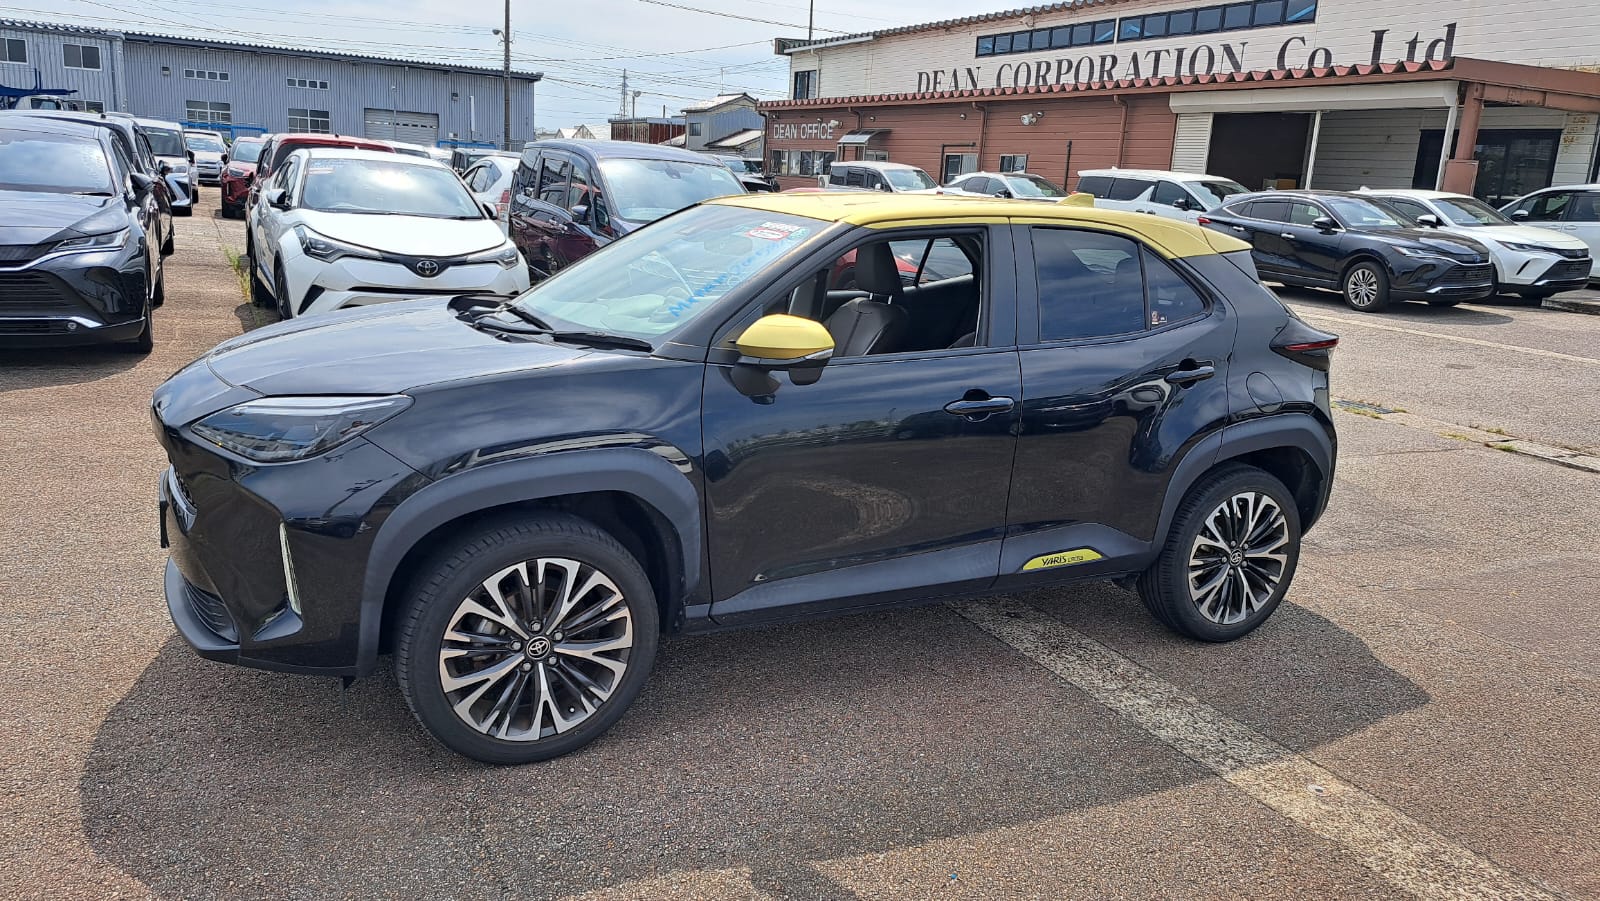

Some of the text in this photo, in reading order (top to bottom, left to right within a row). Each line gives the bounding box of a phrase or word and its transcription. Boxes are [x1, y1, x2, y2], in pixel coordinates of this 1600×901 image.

[917, 66, 981, 94] DEAN
[996, 42, 1248, 90] CORPORATION
[773, 121, 833, 139] DEAN OFFICE
